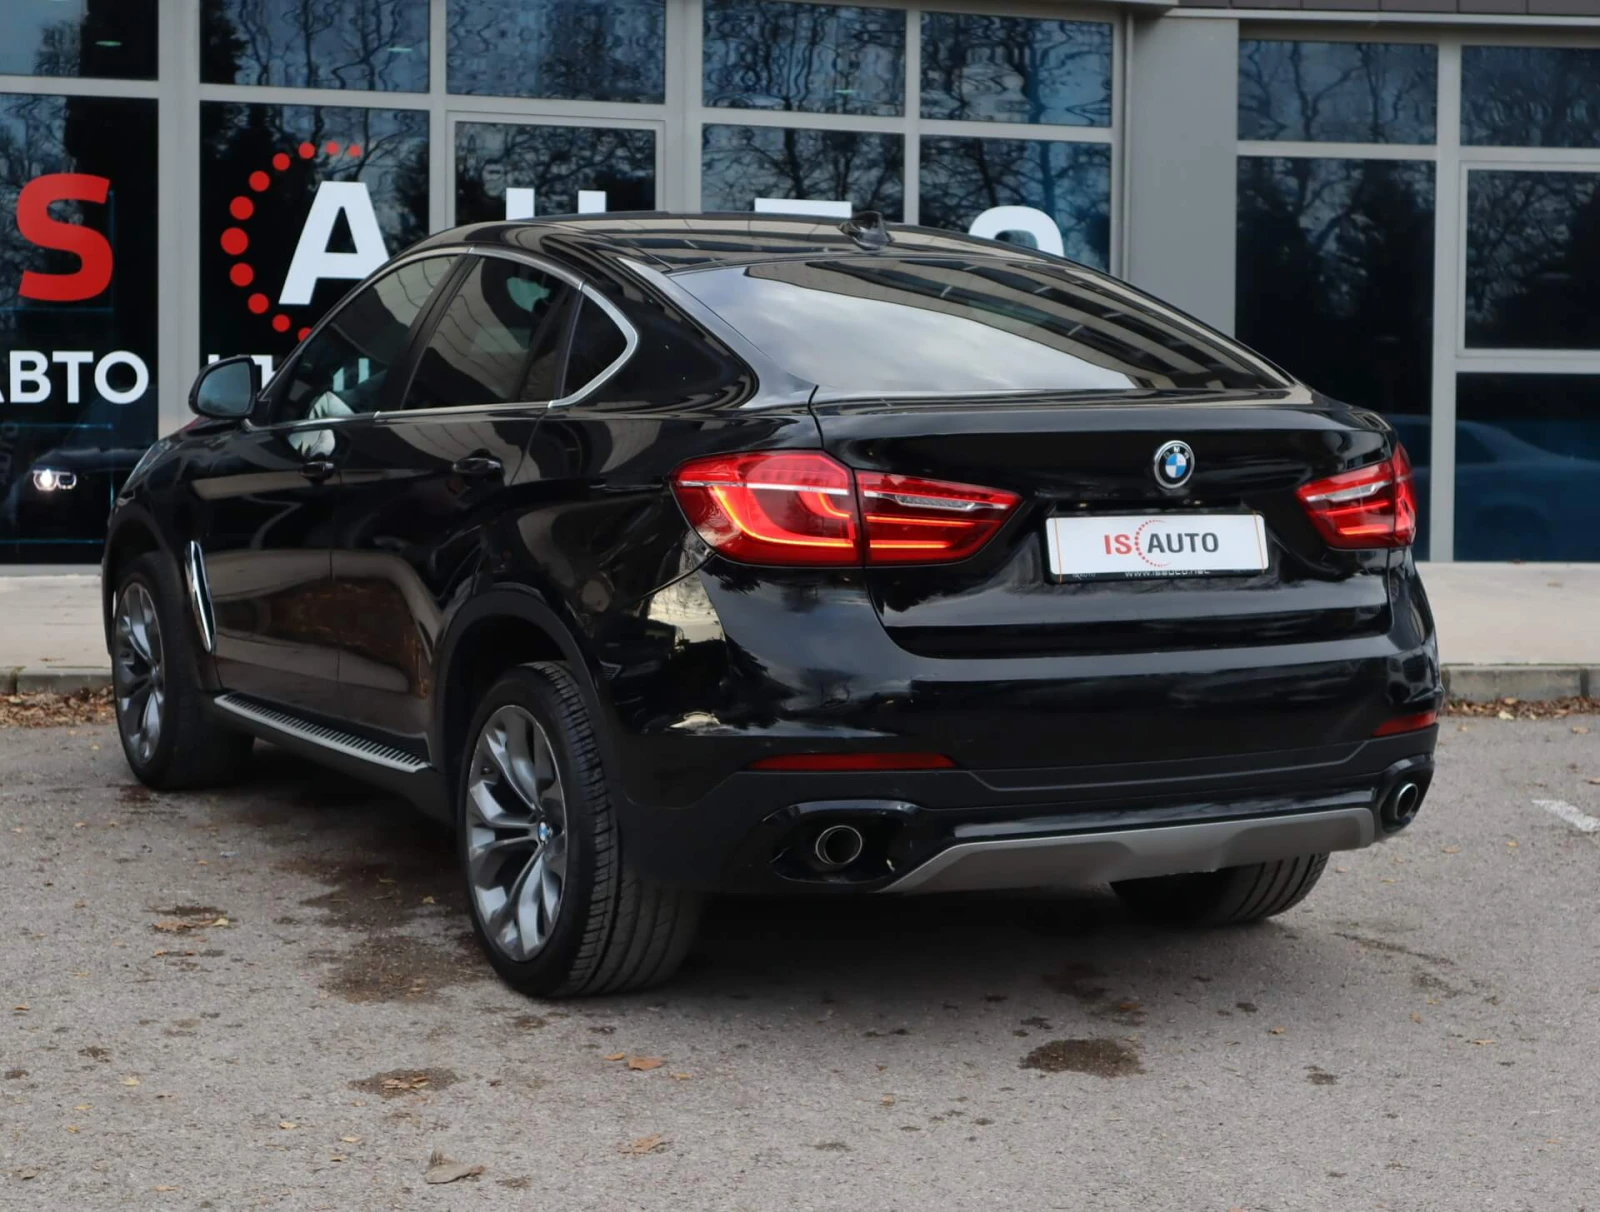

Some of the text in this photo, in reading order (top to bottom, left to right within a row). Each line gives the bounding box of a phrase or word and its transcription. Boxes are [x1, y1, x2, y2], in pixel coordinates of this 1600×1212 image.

[0, 351, 149, 404] ВТО
[1104, 532, 1219, 555] IS AUTO
